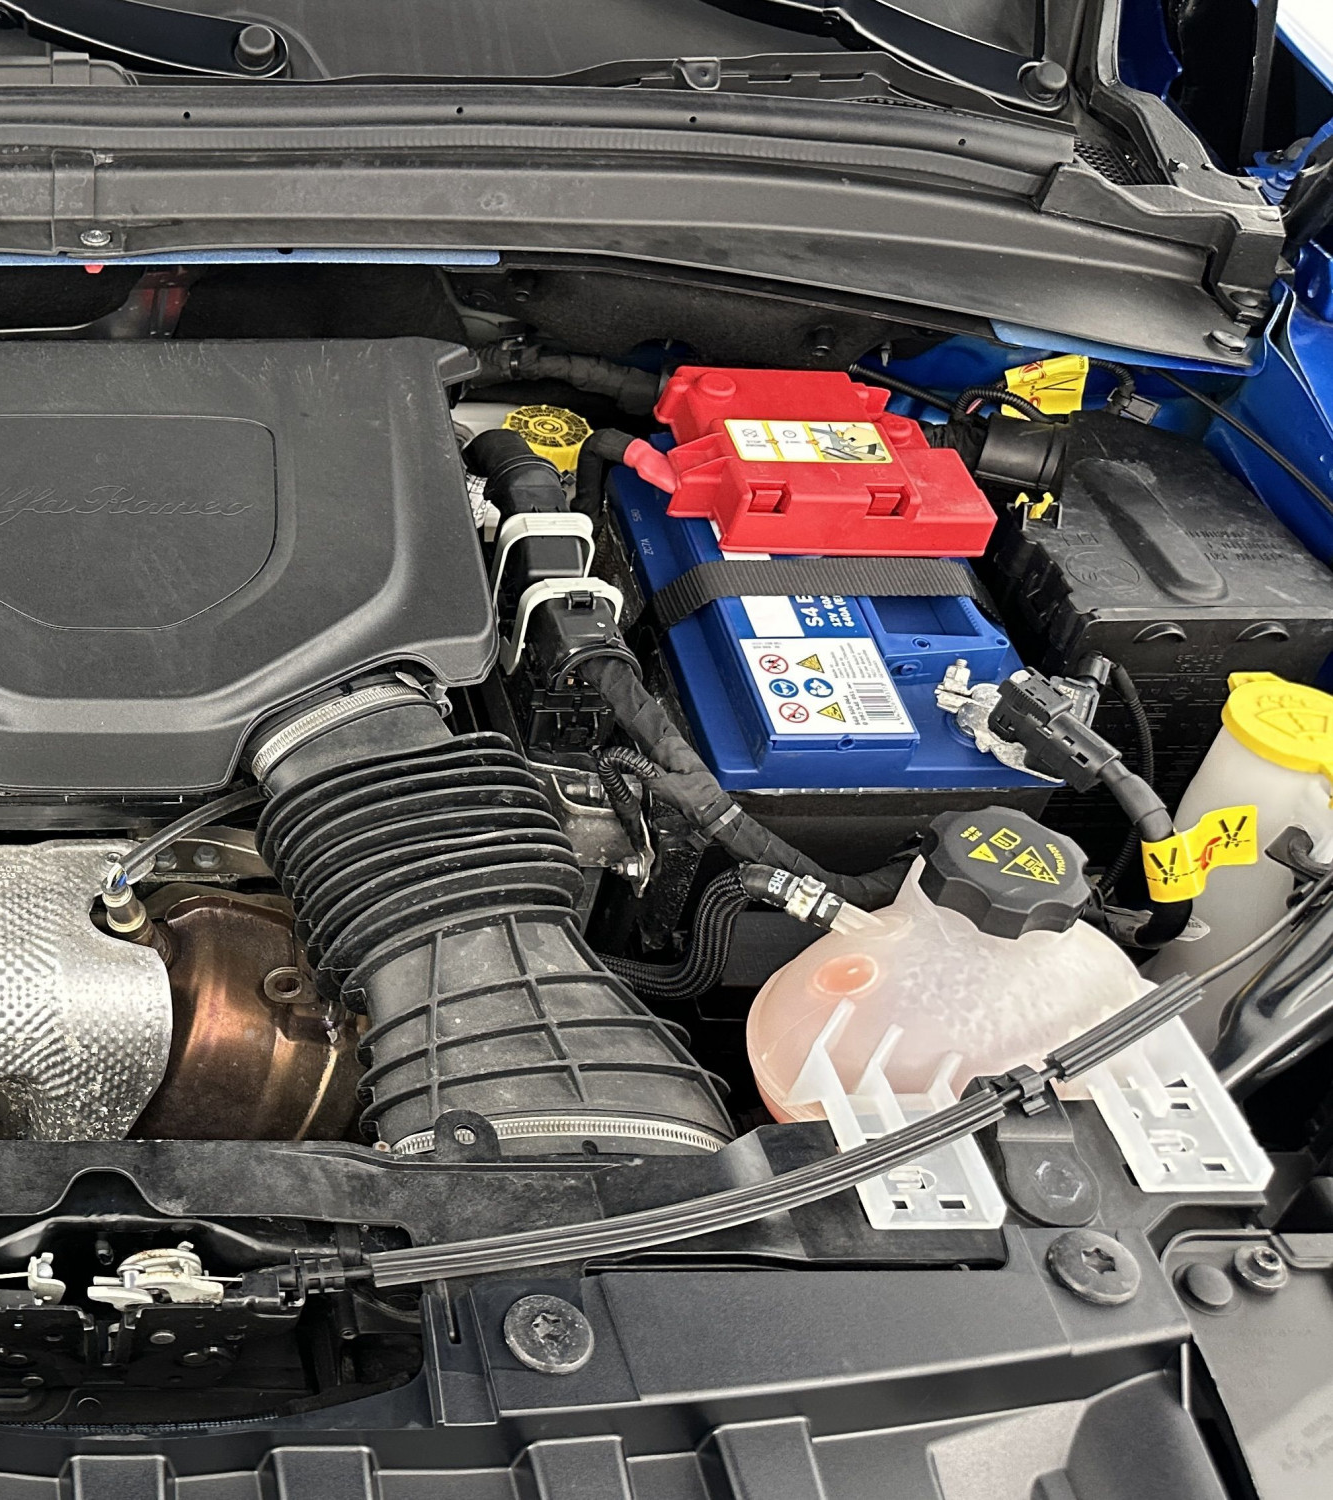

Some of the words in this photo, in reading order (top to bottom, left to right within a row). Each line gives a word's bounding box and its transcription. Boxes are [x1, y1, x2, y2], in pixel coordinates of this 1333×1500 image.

[75, 485, 253, 516] Romeo
[801, 607, 825, 627] S4
[827, 612, 843, 627] 12V
[838, 606, 855, 627] 640A
